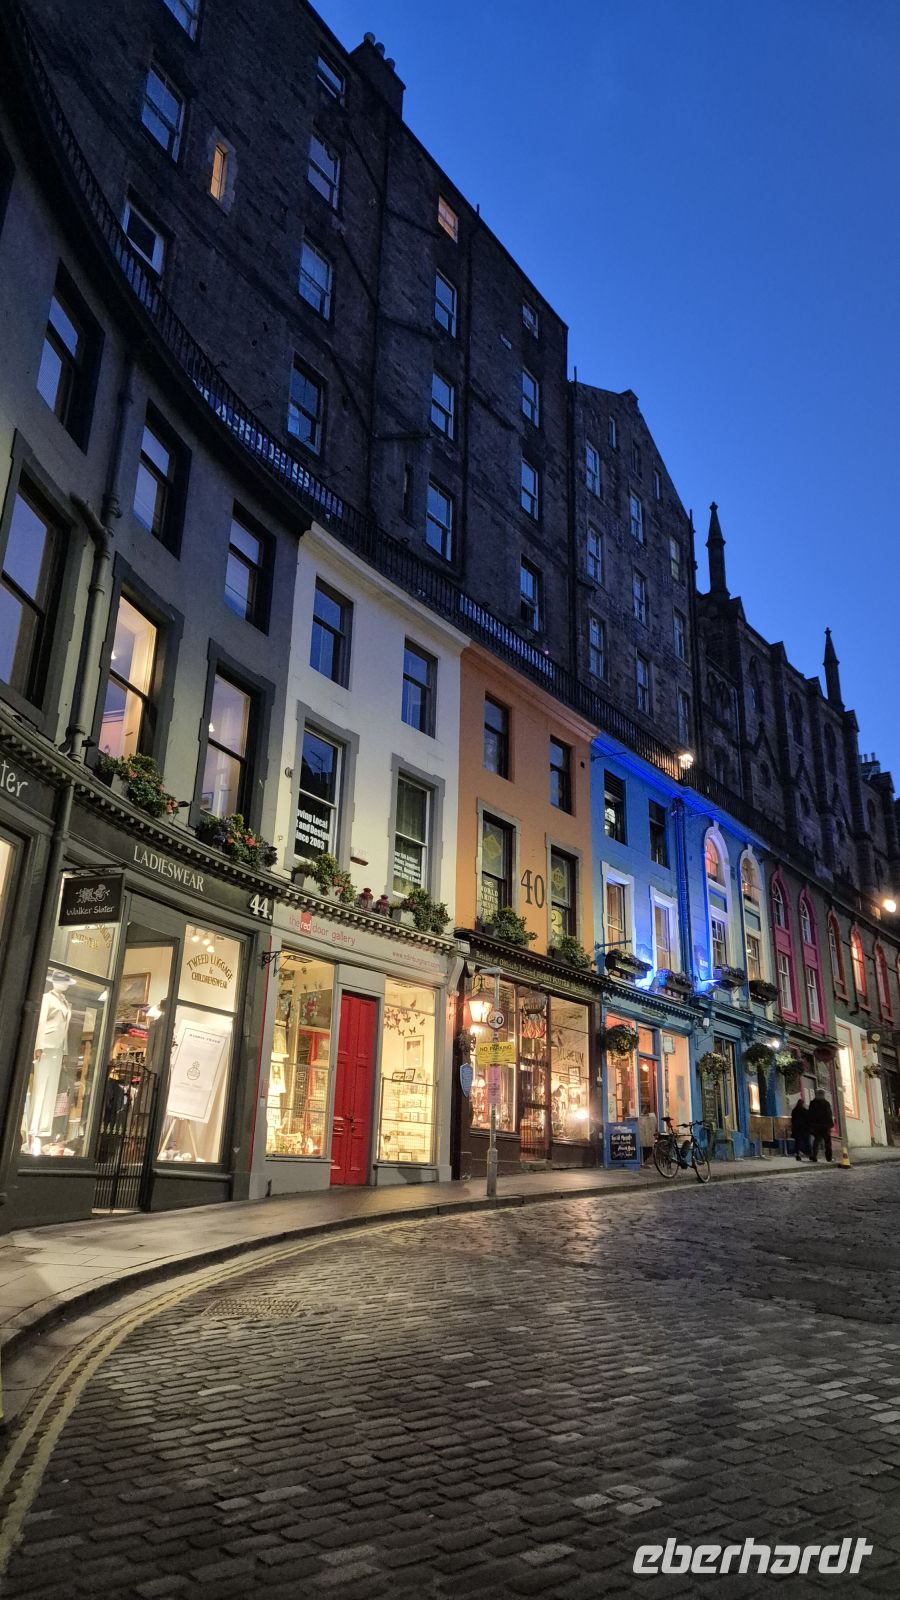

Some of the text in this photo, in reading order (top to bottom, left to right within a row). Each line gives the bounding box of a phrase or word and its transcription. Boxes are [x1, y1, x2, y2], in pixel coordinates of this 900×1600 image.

[312, 814, 328, 829] Local
[133, 846, 204, 892] LADIESWEAR
[520, 869, 544, 908] 40
[66, 905, 115, 916] Walker Slater
[300, 920, 312, 931] red
[312, 923, 329, 936] door
[331, 931, 356, 946] gallery
[187, 954, 233, 982] TWEED LUGGAGE
[191, 971, 228, 989] CHILDRENSWEAR
